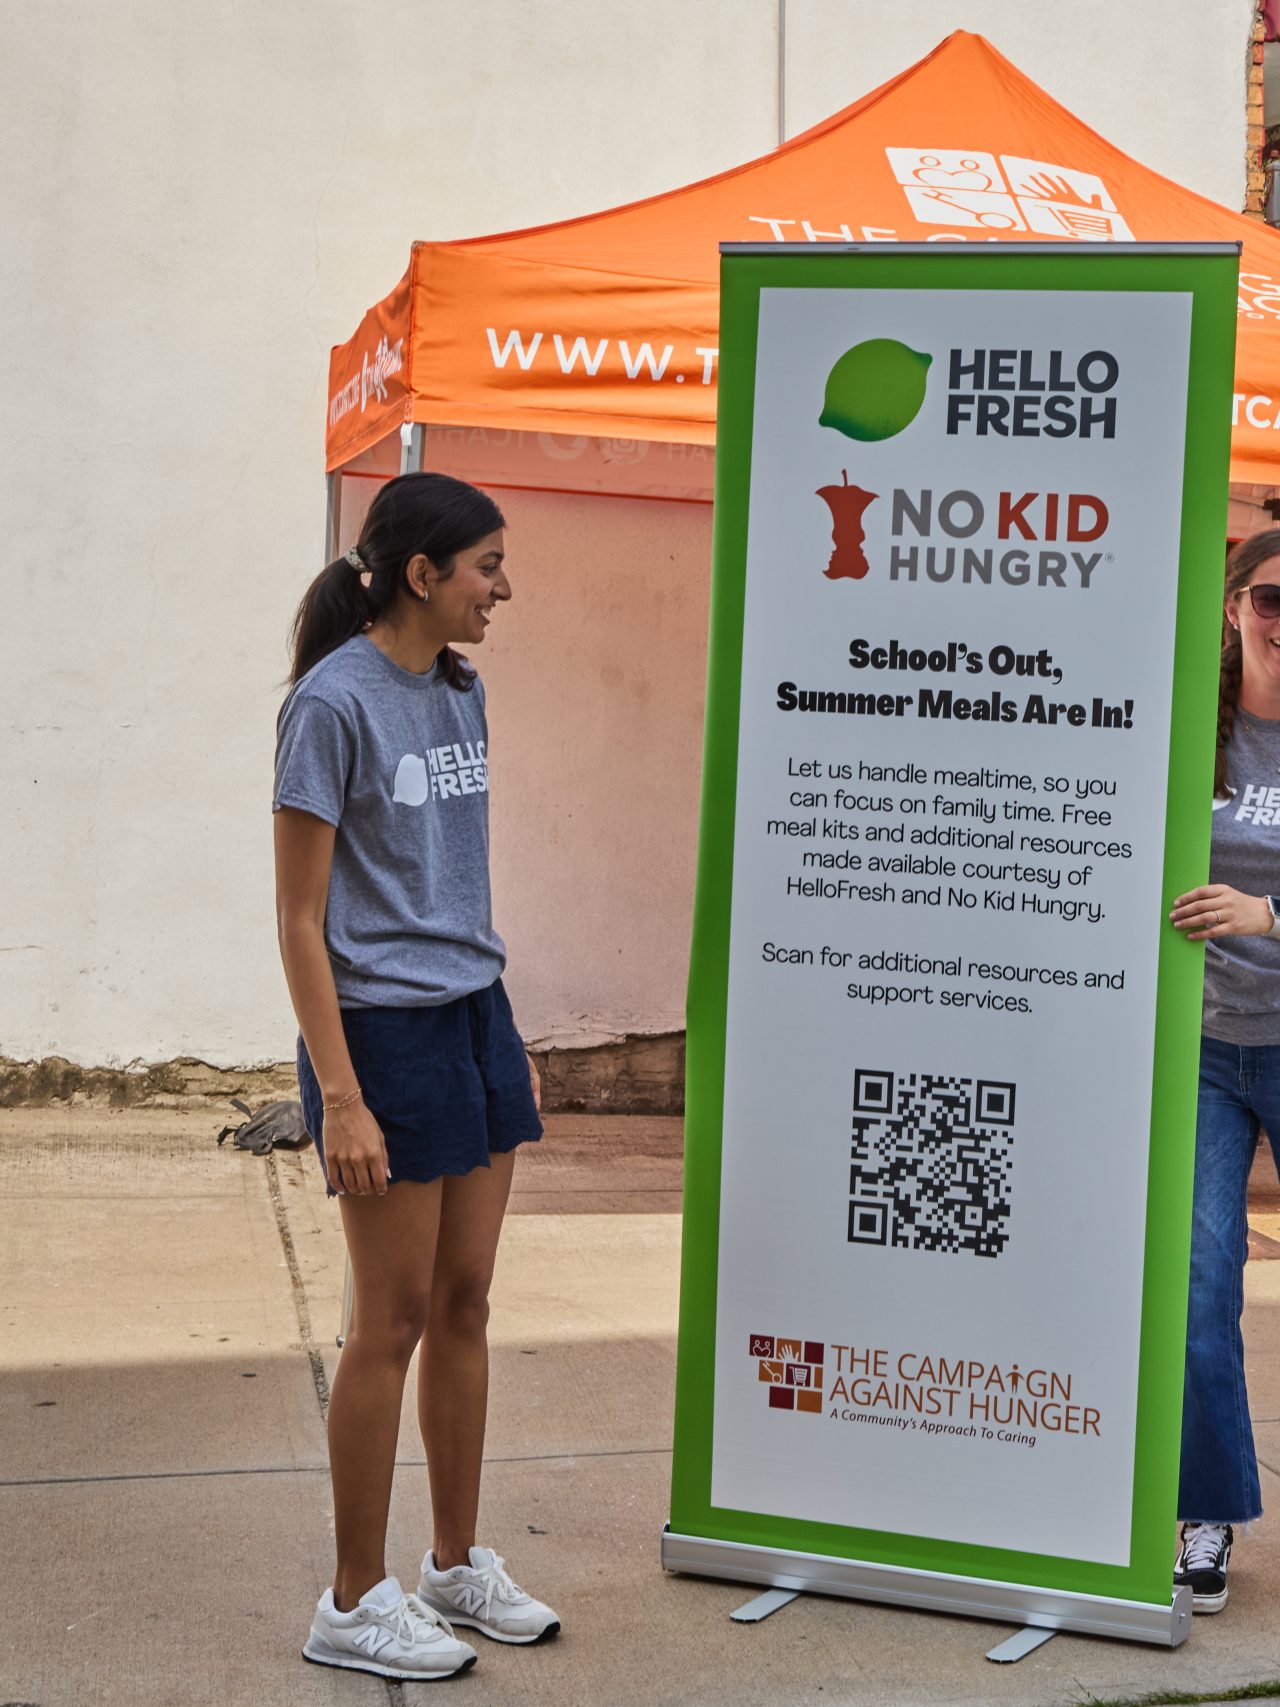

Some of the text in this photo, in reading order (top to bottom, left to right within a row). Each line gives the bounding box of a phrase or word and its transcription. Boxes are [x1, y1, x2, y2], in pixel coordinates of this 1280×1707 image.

[949, 349, 1119, 393] HELLO
[947, 394, 1117, 439] FRESH
[891, 488, 1109, 542] NO KID
[849, 639, 1063, 685] School’s Out,
[776, 681, 1134, 729] Summer Meals Are In!
[788, 757, 1116, 799] Let us handle mealtime, so you
[790, 789, 1111, 826] can focus on family time. Free
[767, 818, 1132, 858] meal kits and additional resources
[803, 850, 1093, 889] made available courtesy of
[787, 876, 1105, 923] HelloFresh and No Kid Hungry.
[762, 942, 1124, 990] Scan for additional resources and
[847, 983, 1032, 1013] support services.
[830, 1344, 888, 1377] THE
[829, 1376, 1101, 1436] AGAINST HUNGER
[830, 1408, 838, 1420] A
[920, 1419, 977, 1438] Approach
[981, 1427, 994, 1439] To
[997, 1429, 1036, 1447] Caring
